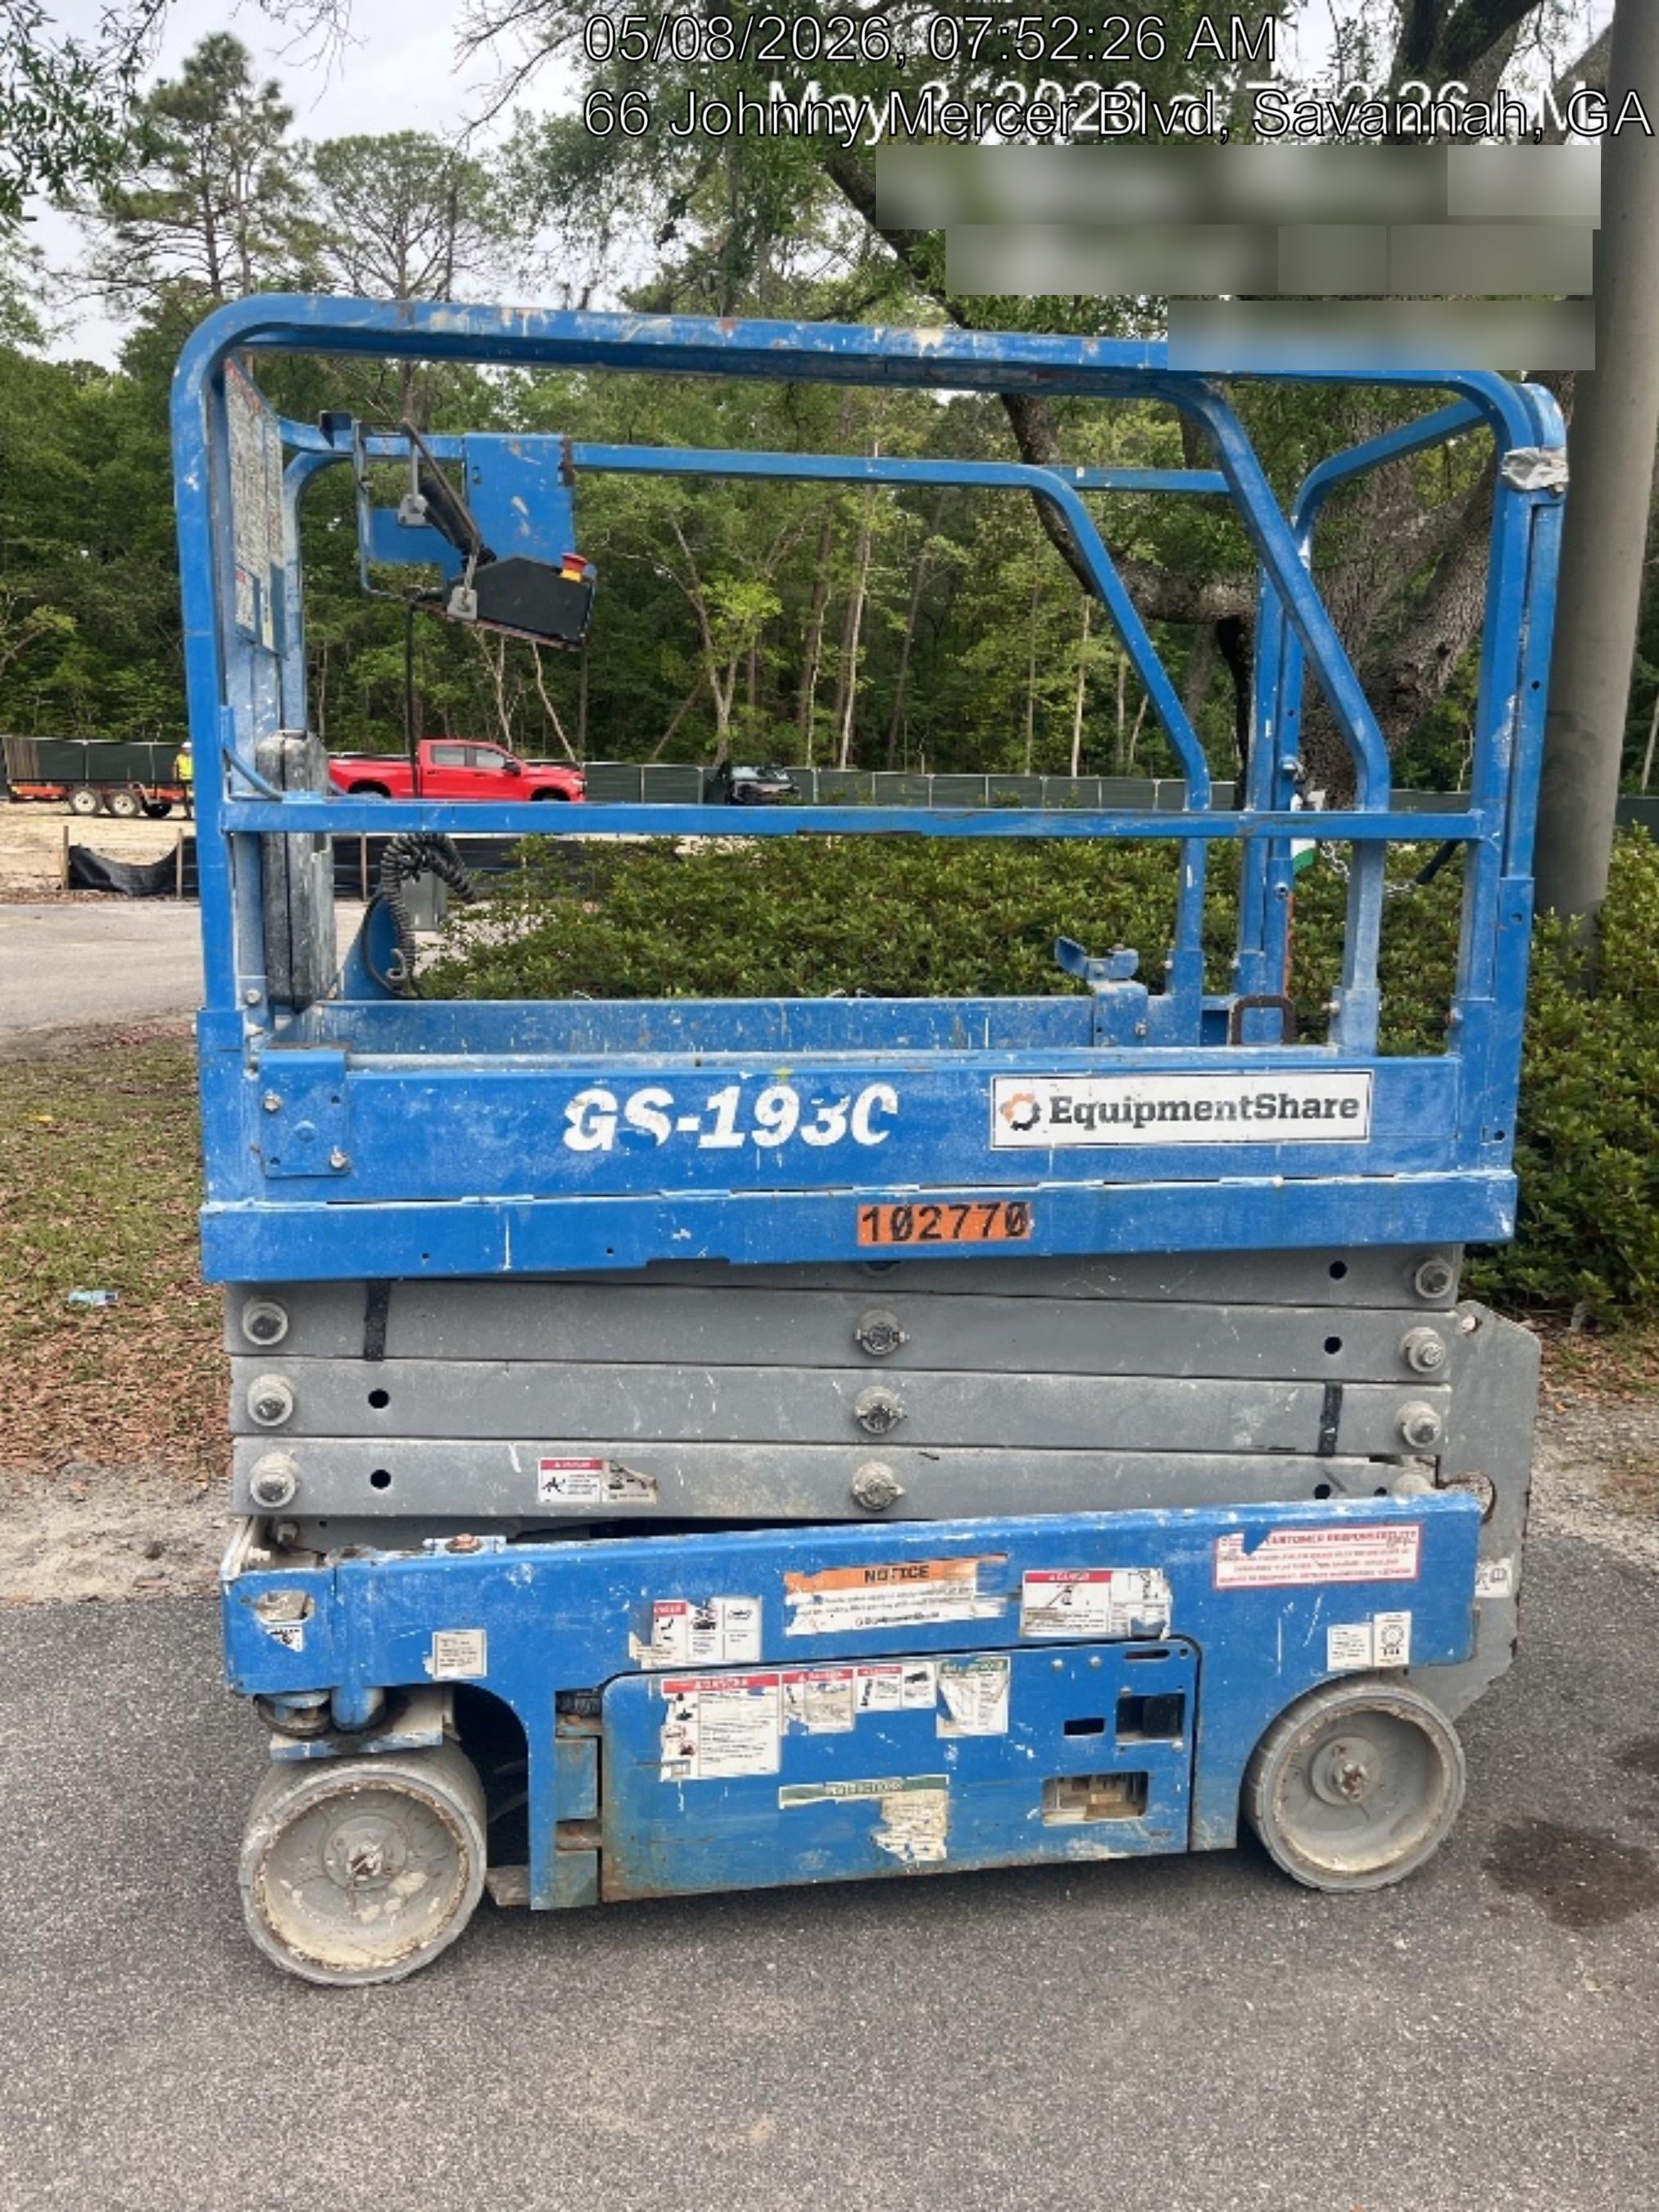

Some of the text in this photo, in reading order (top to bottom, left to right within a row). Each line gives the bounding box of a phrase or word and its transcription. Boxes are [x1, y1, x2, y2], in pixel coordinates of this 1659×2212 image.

[1048, 1092, 1359, 1129] EquipmentShare
[862, 1202, 1031, 1243] 102770
[864, 1565, 930, 1584] NOTICE
